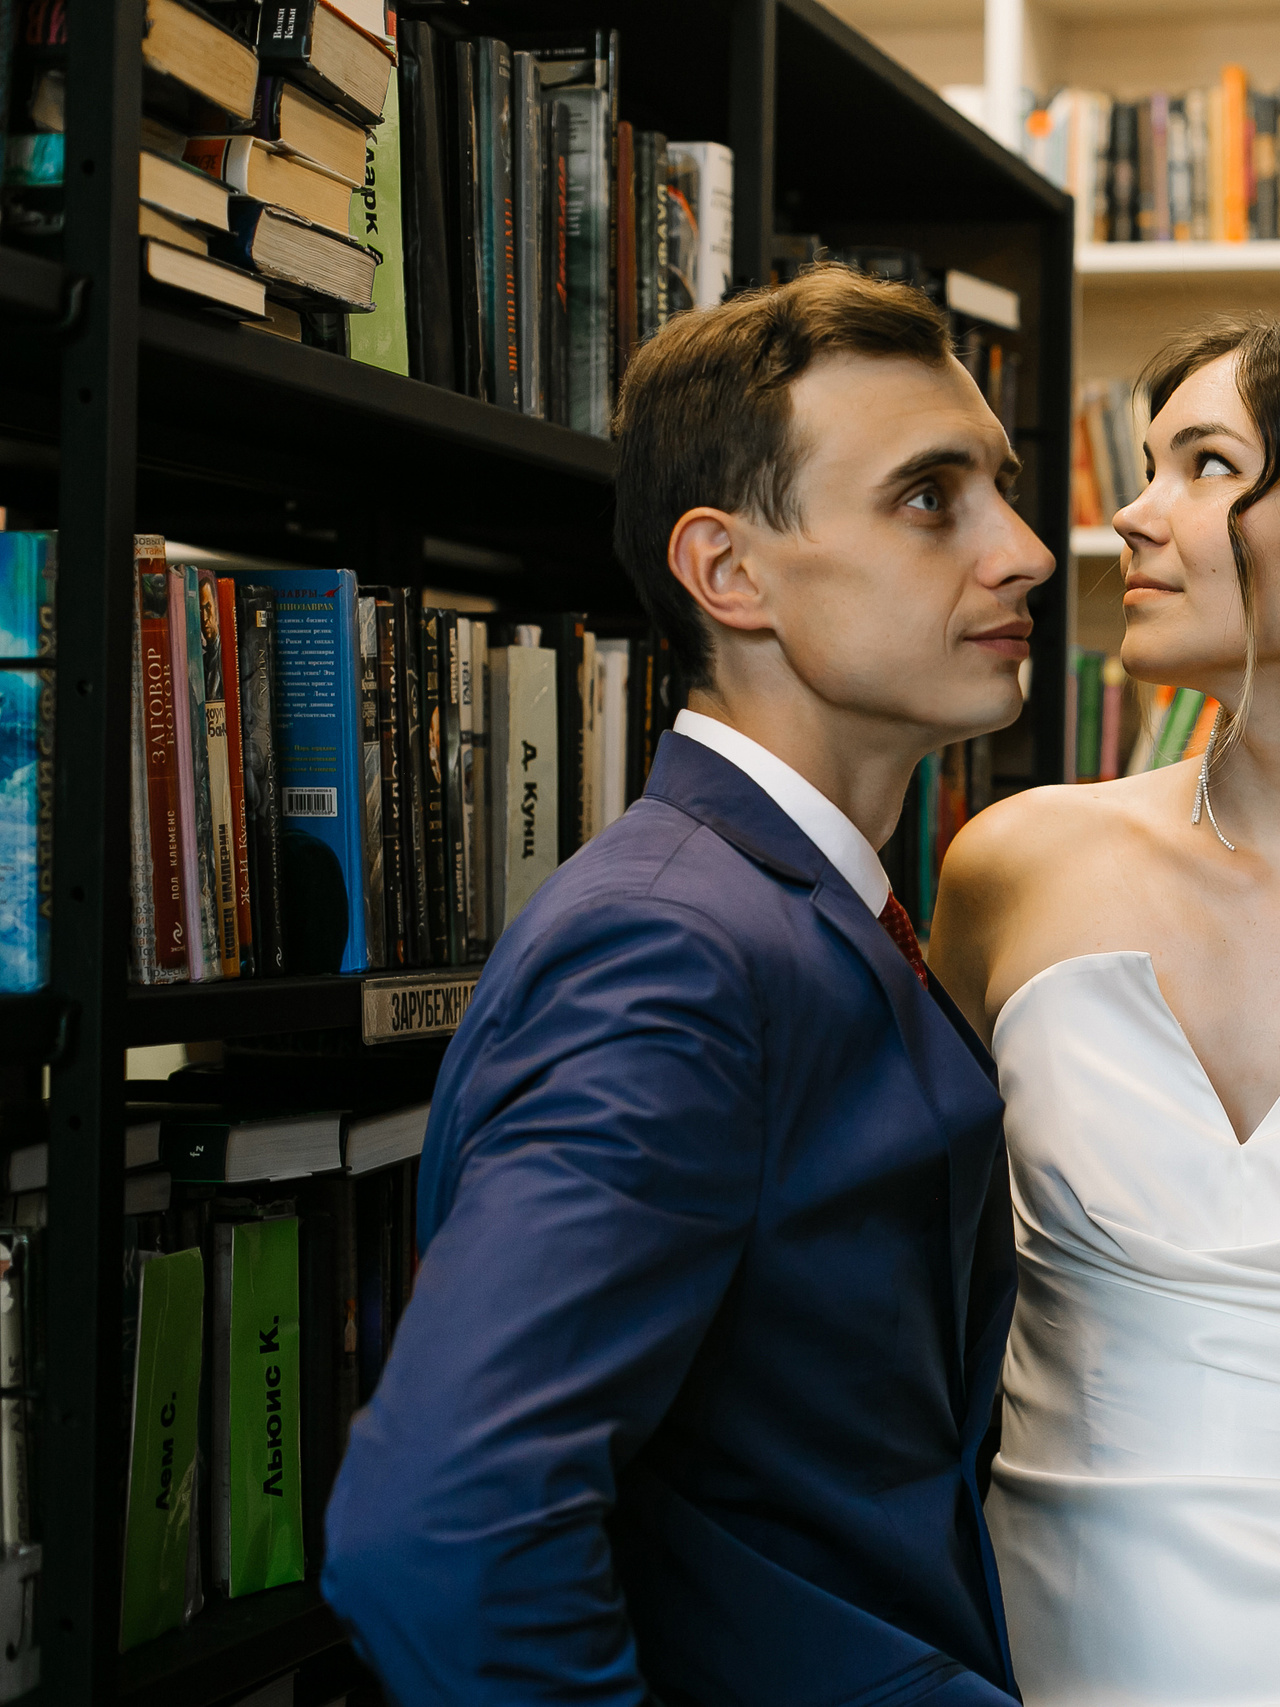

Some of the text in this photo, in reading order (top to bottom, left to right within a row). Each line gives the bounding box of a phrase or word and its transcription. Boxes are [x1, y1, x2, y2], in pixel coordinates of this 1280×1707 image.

[272, 8, 285, 39] Волки
[284, 8, 297, 39] Кальи
[147, 647, 166, 765] ЗАГОВОР
[166, 809, 180, 900] ПОЛ КЛЕМЕНС
[521, 782, 539, 859] Кунц
[218, 824, 236, 959] КОНЕЦ ИМПЕРИИ
[392, 985, 475, 1031] ЗАРУБЕЖНА
[155, 1392, 178, 1510] Лем С.
[260, 1315, 284, 1496] Льюис К.
